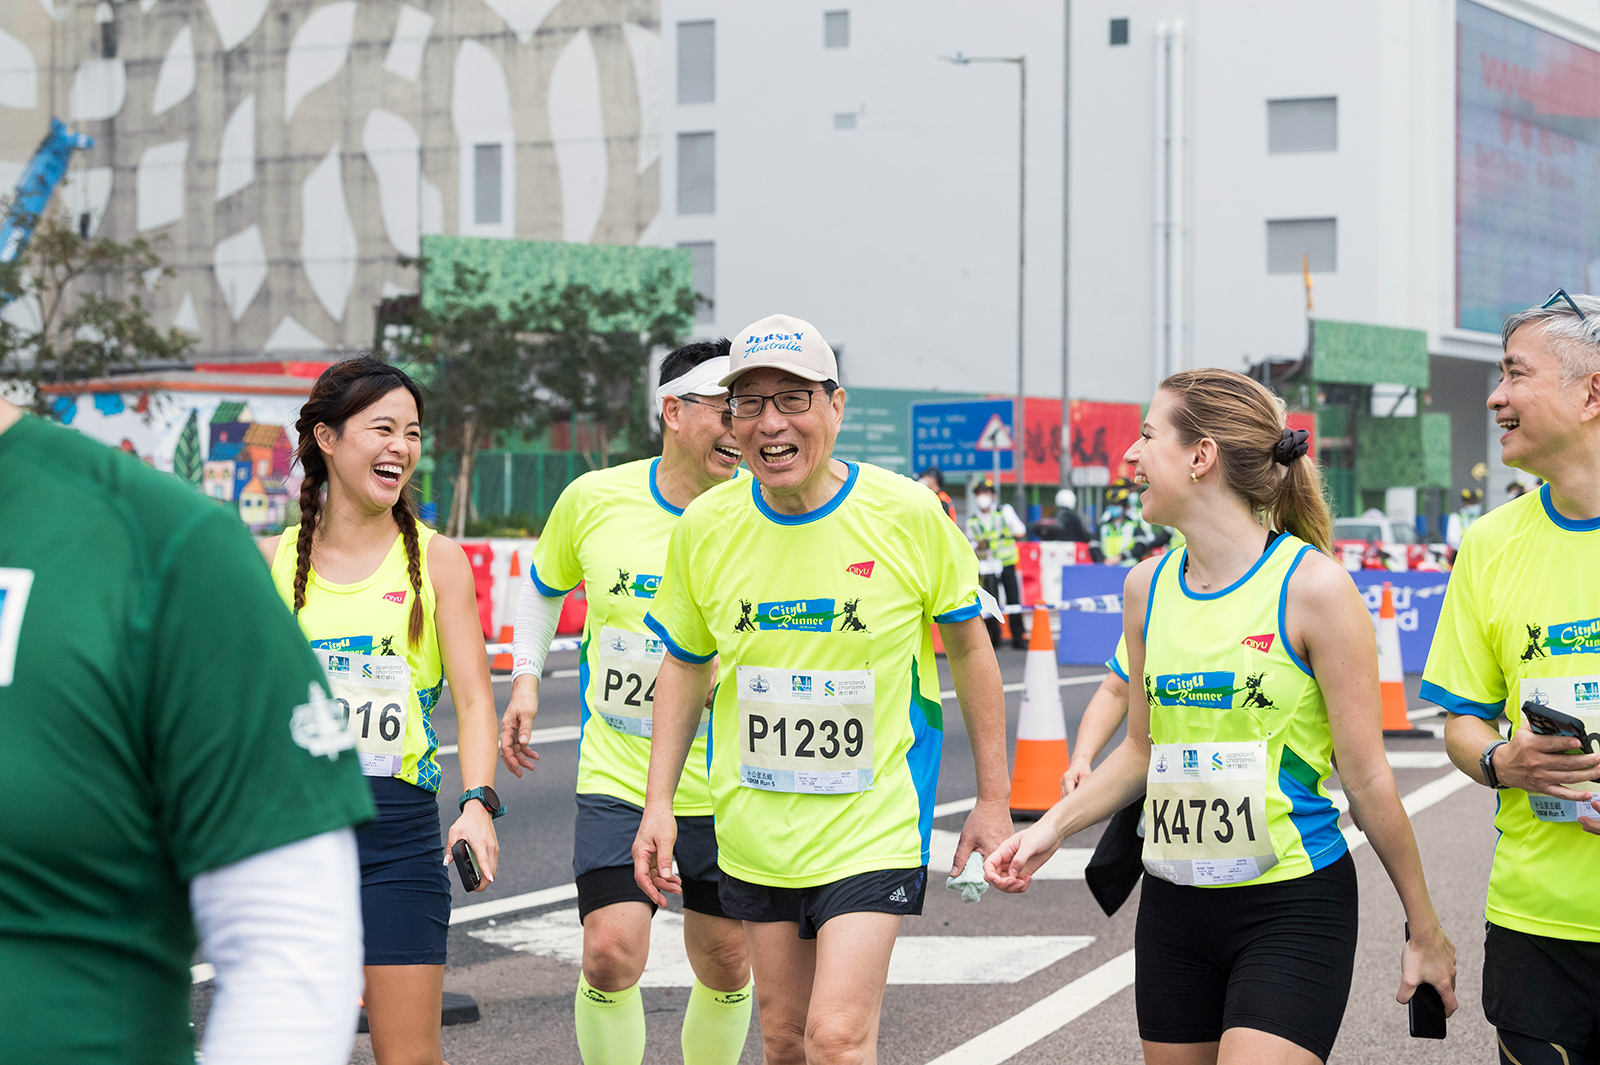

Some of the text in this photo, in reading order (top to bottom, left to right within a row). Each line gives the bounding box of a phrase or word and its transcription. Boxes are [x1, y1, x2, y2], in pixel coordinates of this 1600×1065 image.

[746, 333, 804, 344] JERSEY
[743, 341, 803, 358] Australia
[849, 566, 869, 576] CityU
[384, 594, 402, 602] CityU
[768, 602, 807, 621] CityU
[778, 614, 824, 628] Runner
[1244, 638, 1268, 650] CityU
[1166, 675, 1205, 695] CityU
[1176, 689, 1223, 704] Runner
[748, 714, 864, 759] P1239
[1152, 796, 1256, 844] K4731
